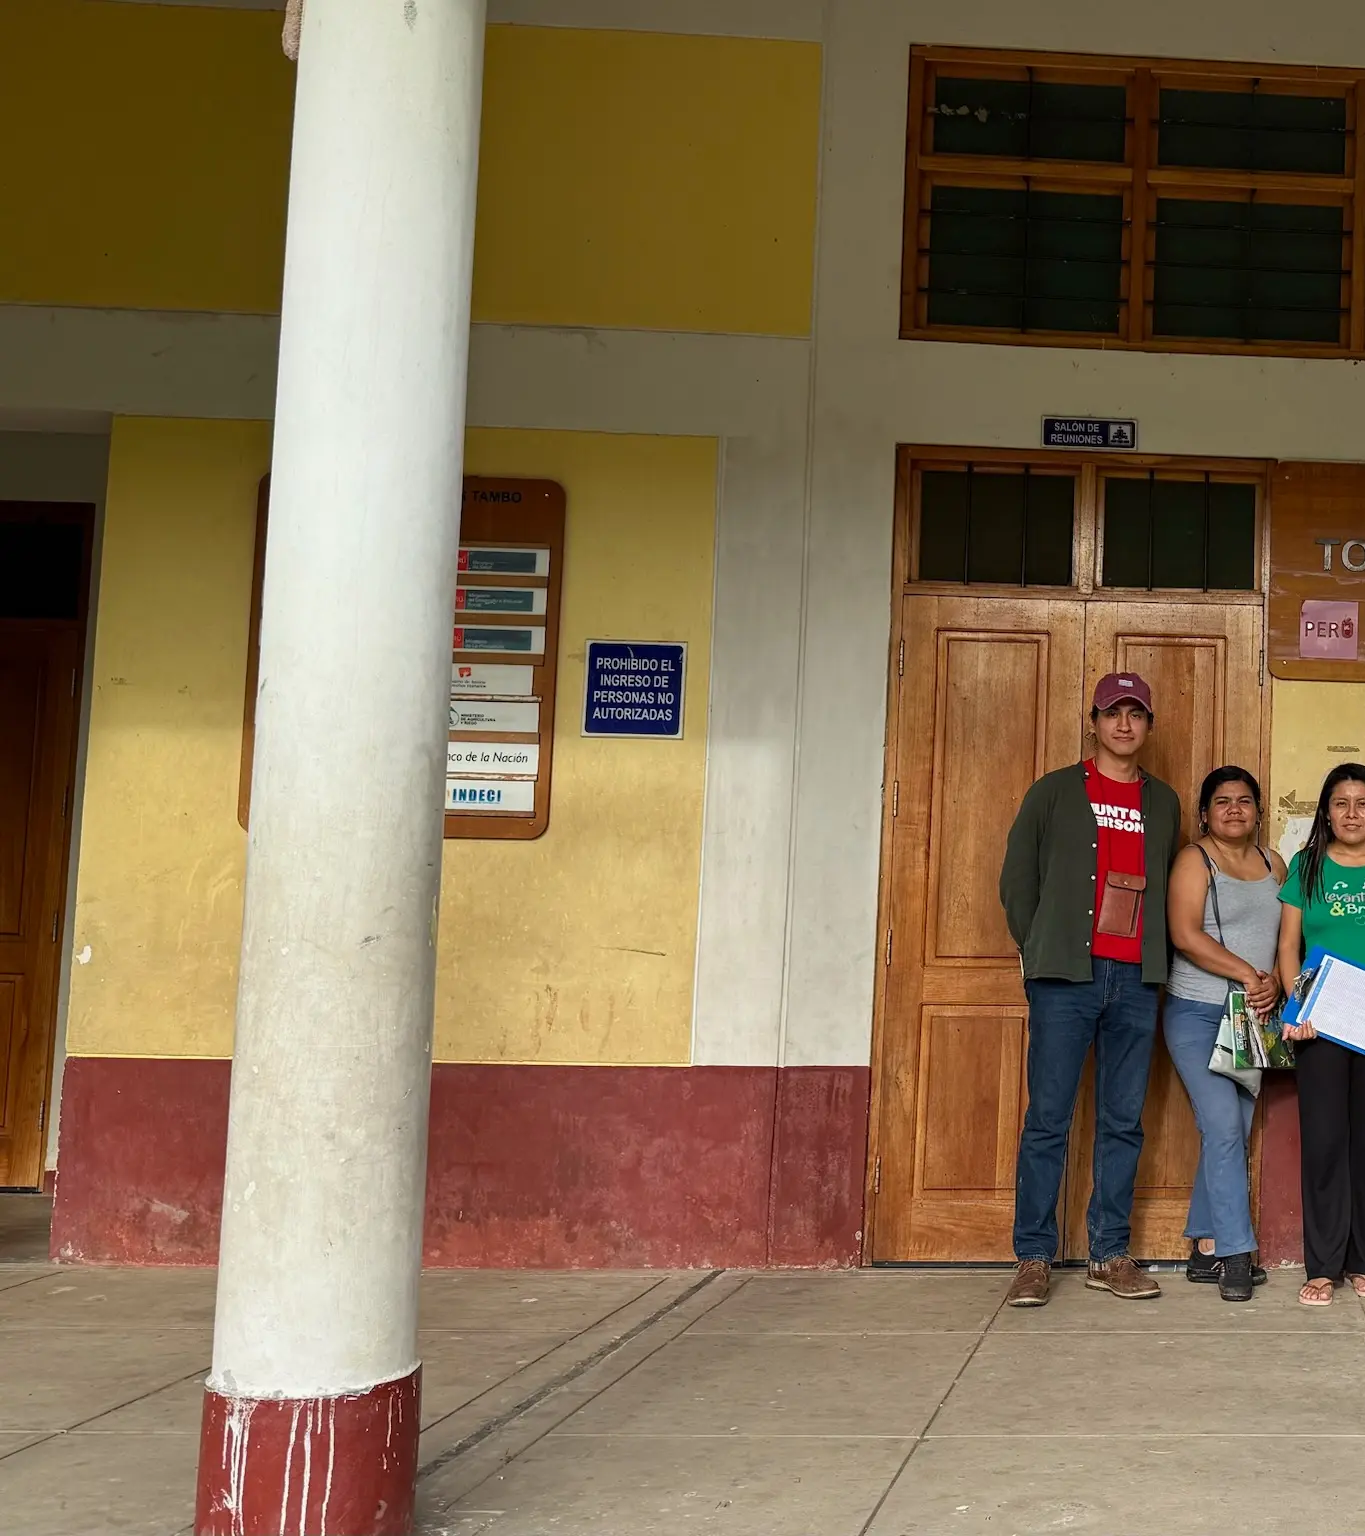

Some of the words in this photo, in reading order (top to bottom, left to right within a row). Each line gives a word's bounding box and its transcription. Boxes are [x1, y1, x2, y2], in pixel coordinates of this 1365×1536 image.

[1054, 421, 1085, 432] SALÓN
[1087, 423, 1100, 432] DE
[1050, 433, 1103, 444] REUNIONES
[472, 490, 522, 503] TAMBO
[1304, 617, 1354, 639] PERÚ
[596, 657, 658, 671] PROHIBIDO
[661, 659, 675, 672] EL
[600, 673, 651, 688] INGRESO
[653, 675, 669, 688] DE
[593, 690, 655, 704] PERSONAS
[657, 692, 674, 705] NO
[592, 706, 673, 721] AUTORIZADAS
[465, 751, 477, 762] de
[480, 751, 490, 762] la
[492, 751, 528, 763] Nación
[452, 788, 502, 802] INDECI
[1330, 901, 1345, 917] &
